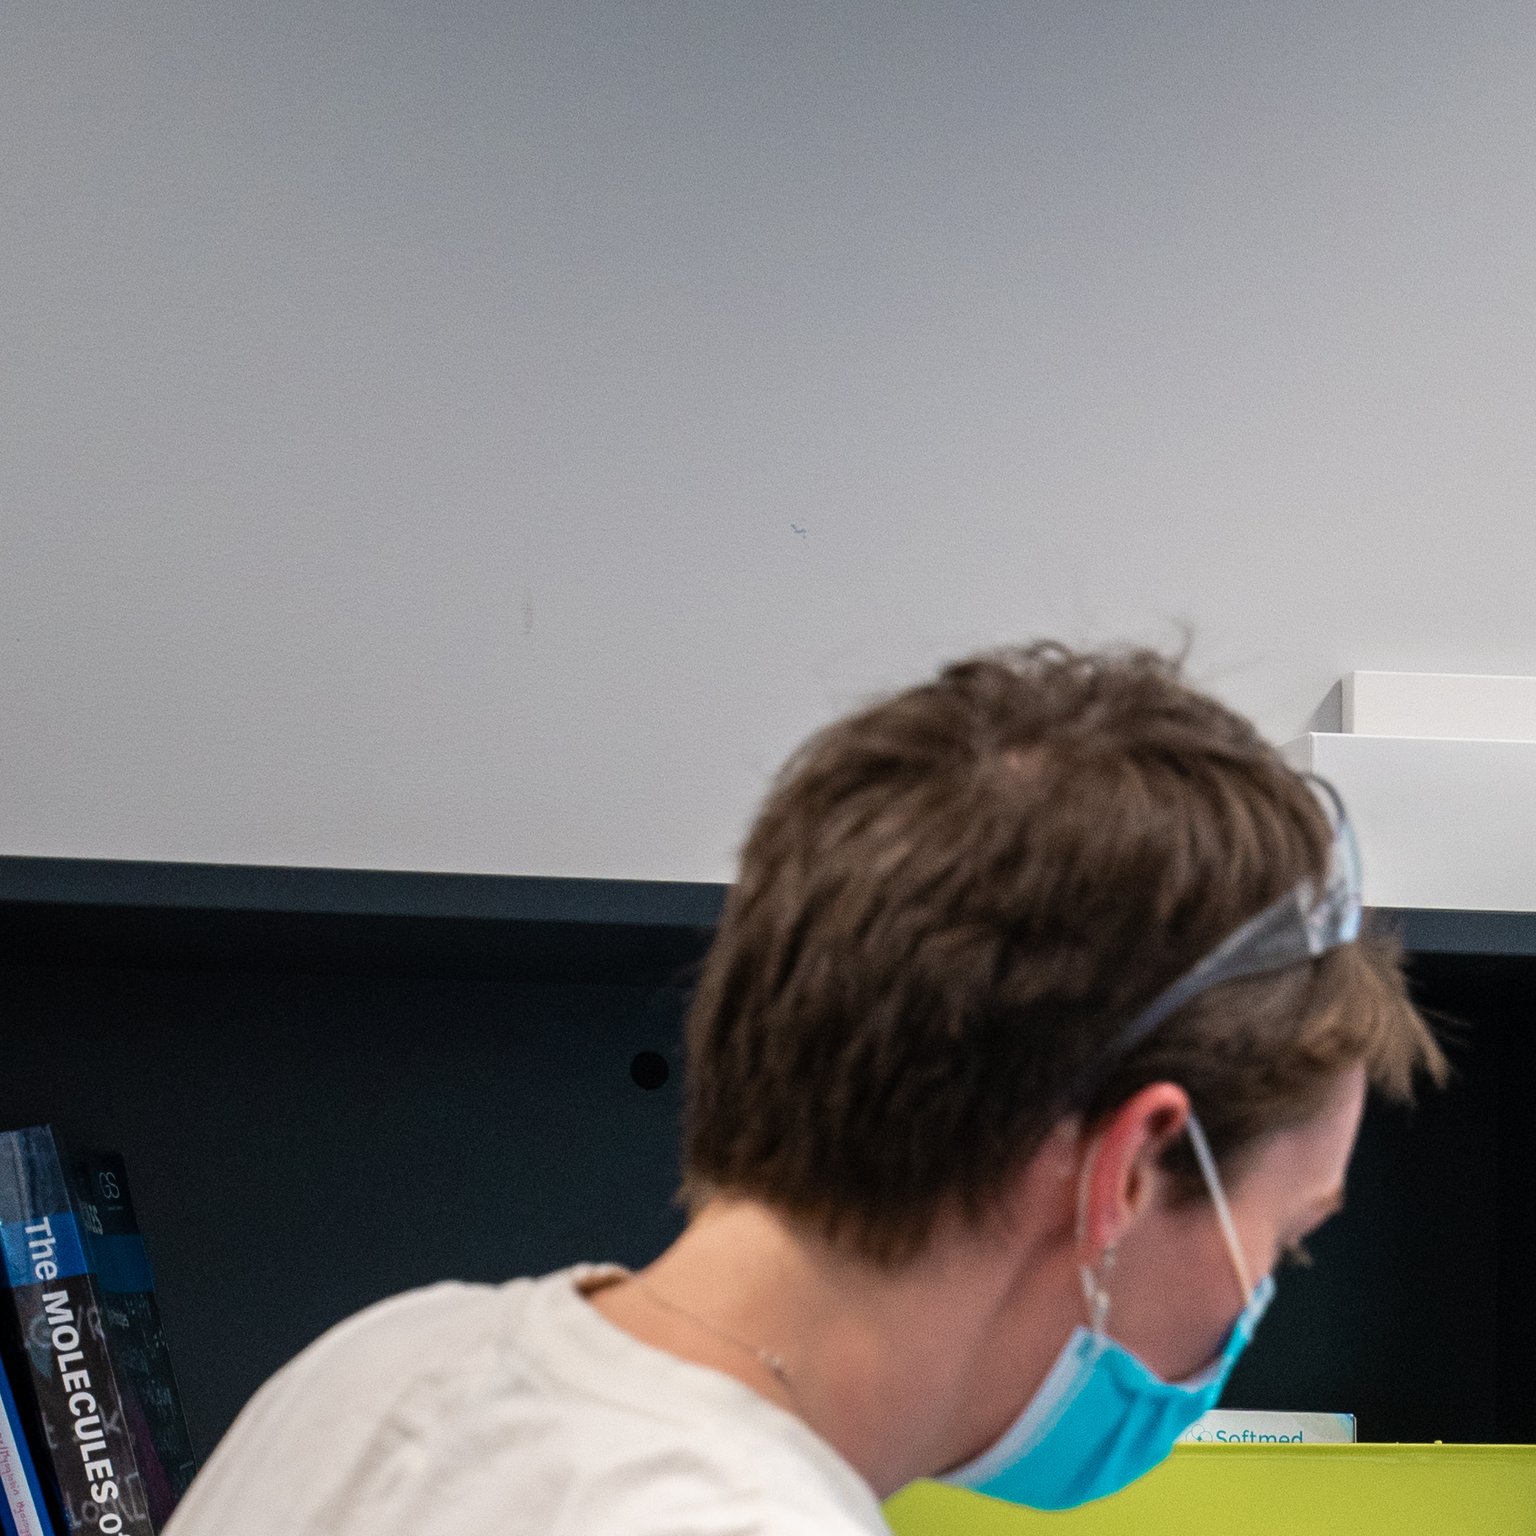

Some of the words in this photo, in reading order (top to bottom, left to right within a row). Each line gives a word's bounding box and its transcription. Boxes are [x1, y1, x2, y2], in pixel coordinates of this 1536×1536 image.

[25, 1216, 58, 1280] The
[42, 1289, 119, 1505] MOLECULES
[1216, 1430, 1303, 1443] Softmed
